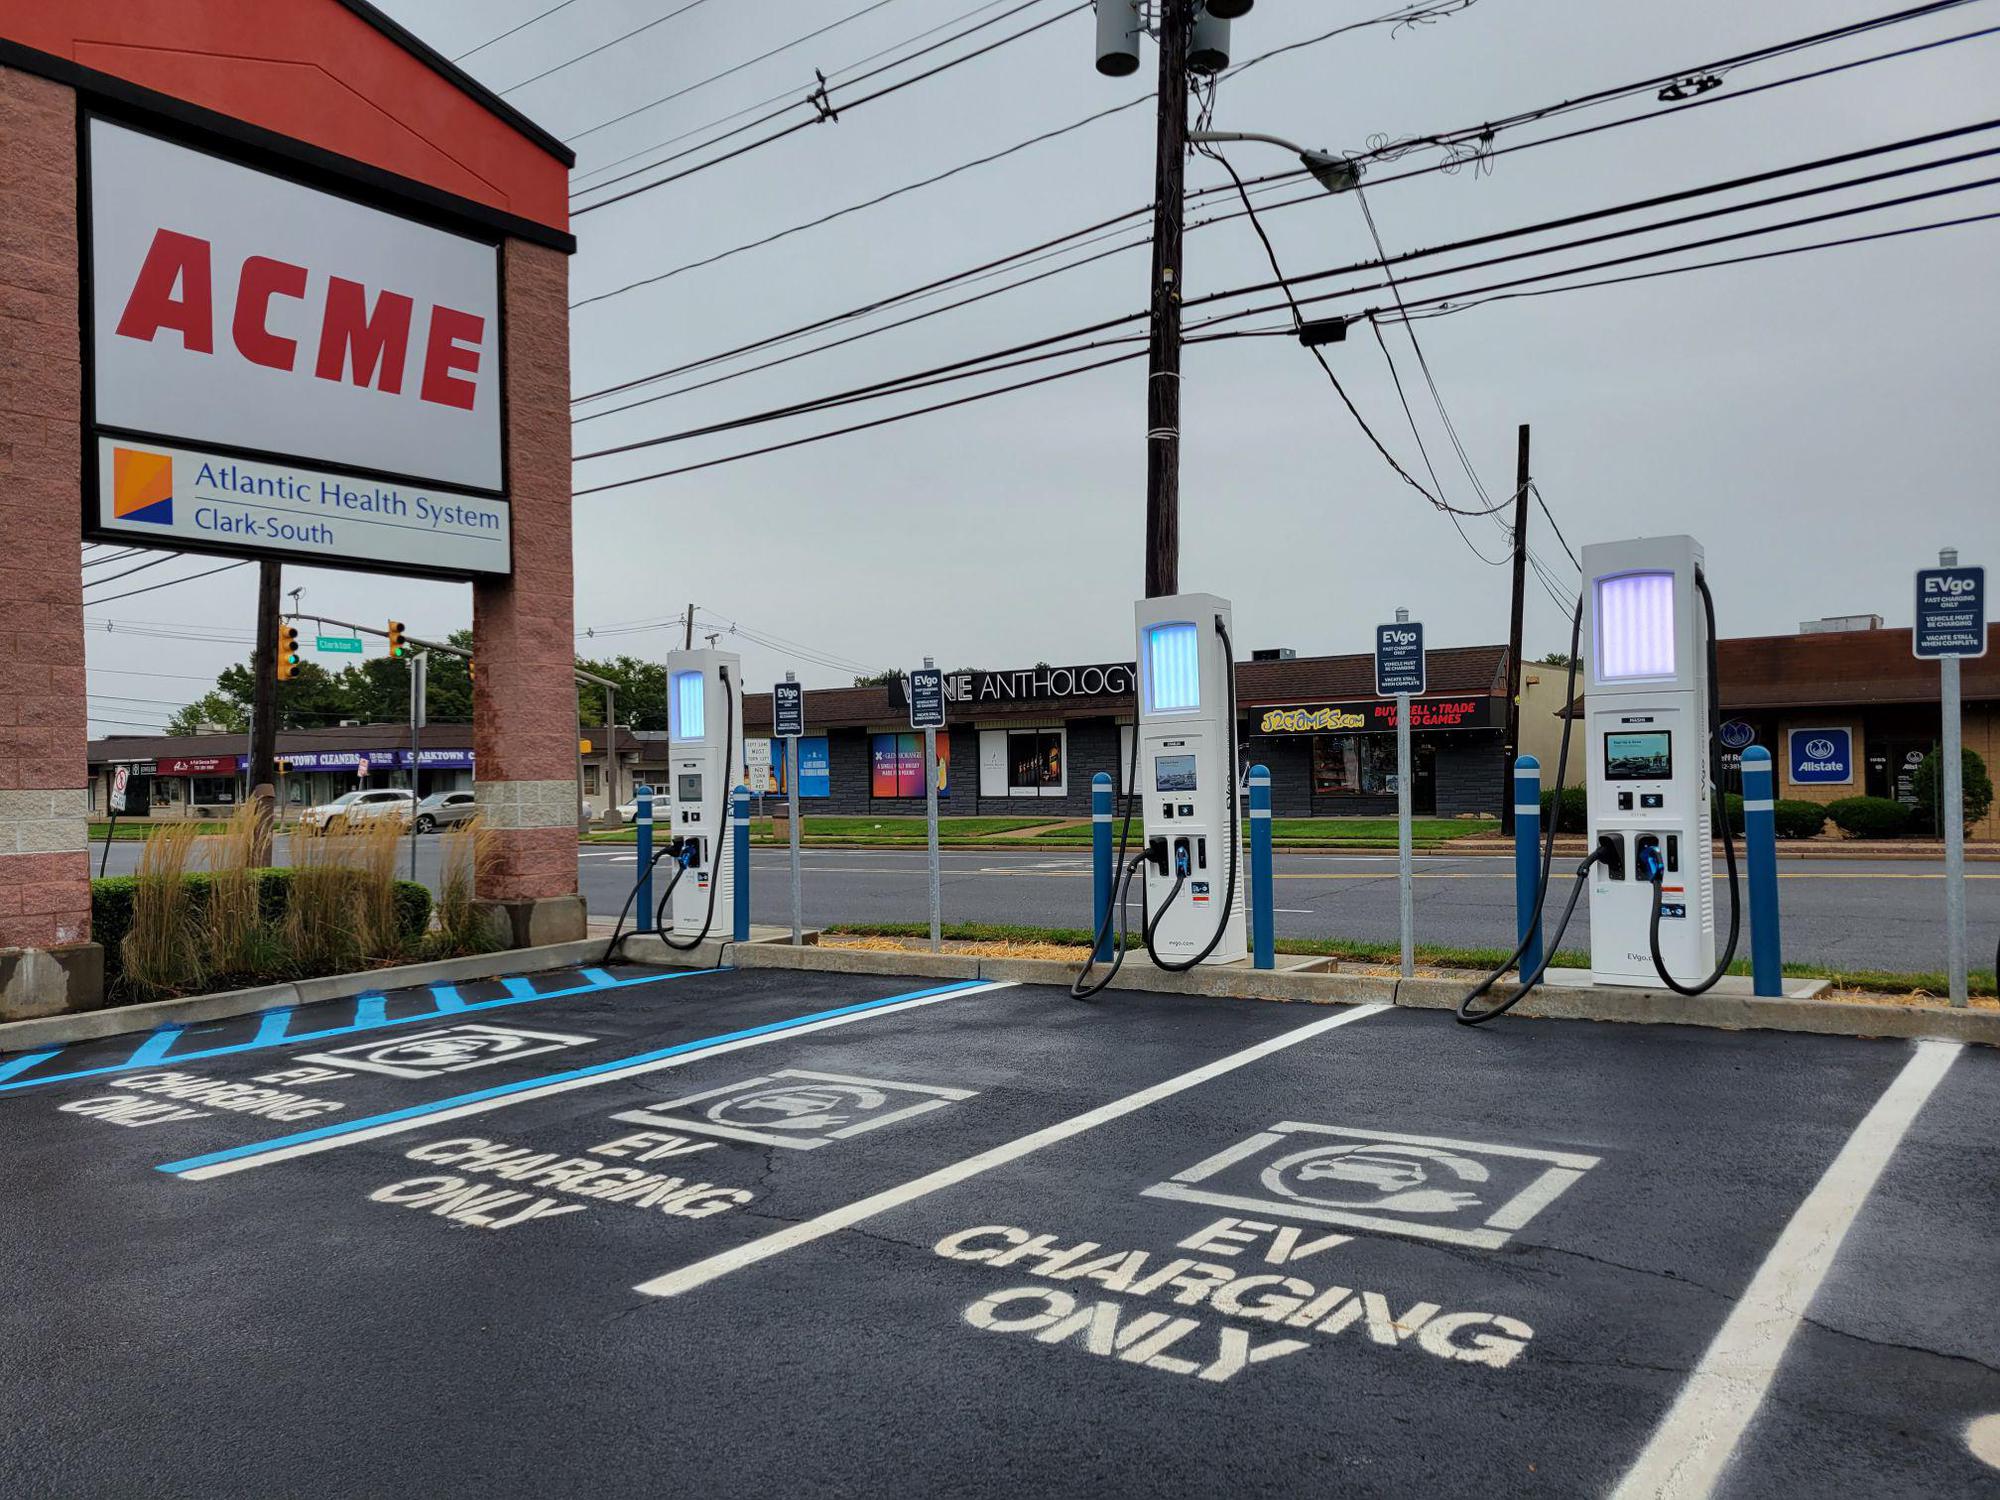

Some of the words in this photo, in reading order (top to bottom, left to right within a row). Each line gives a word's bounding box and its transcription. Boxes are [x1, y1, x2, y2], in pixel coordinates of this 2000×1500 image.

[115, 228, 485, 411] ACME
[195, 462, 311, 503] Atlantic
[320, 481, 407, 517] Health
[416, 497, 500, 530] System
[195, 508, 334, 545] Clark-South
[1925, 577, 1975, 595] EVgo
[1383, 630, 1417, 645] EVgo
[778, 688, 798, 699] EVgo
[914, 676, 938, 687] EVgo
[979, 665, 1137, 701] ANTHOLOGY
[1375, 706, 1397, 717] BUY
[1409, 704, 1430, 715] ELL
[1439, 703, 1476, 713] TRADE
[1423, 714, 1462, 725] GAMES
[320, 753, 360, 765] CLEANERS
[407, 752, 464, 760] CARKTOWN
[1799, 762, 1844, 772] Allstate
[251, 1067, 355, 1086] EV
[57, 1095, 213, 1128] ONLY
[110, 1072, 346, 1122] CHARGING
[587, 1132, 719, 1163] EV
[405, 1138, 754, 1219] CHARGING
[369, 1176, 587, 1230] ONLY
[1178, 1217, 1354, 1264] EV
[934, 1225, 1535, 1368] CHARGING
[963, 1287, 1311, 1382] ONLY
